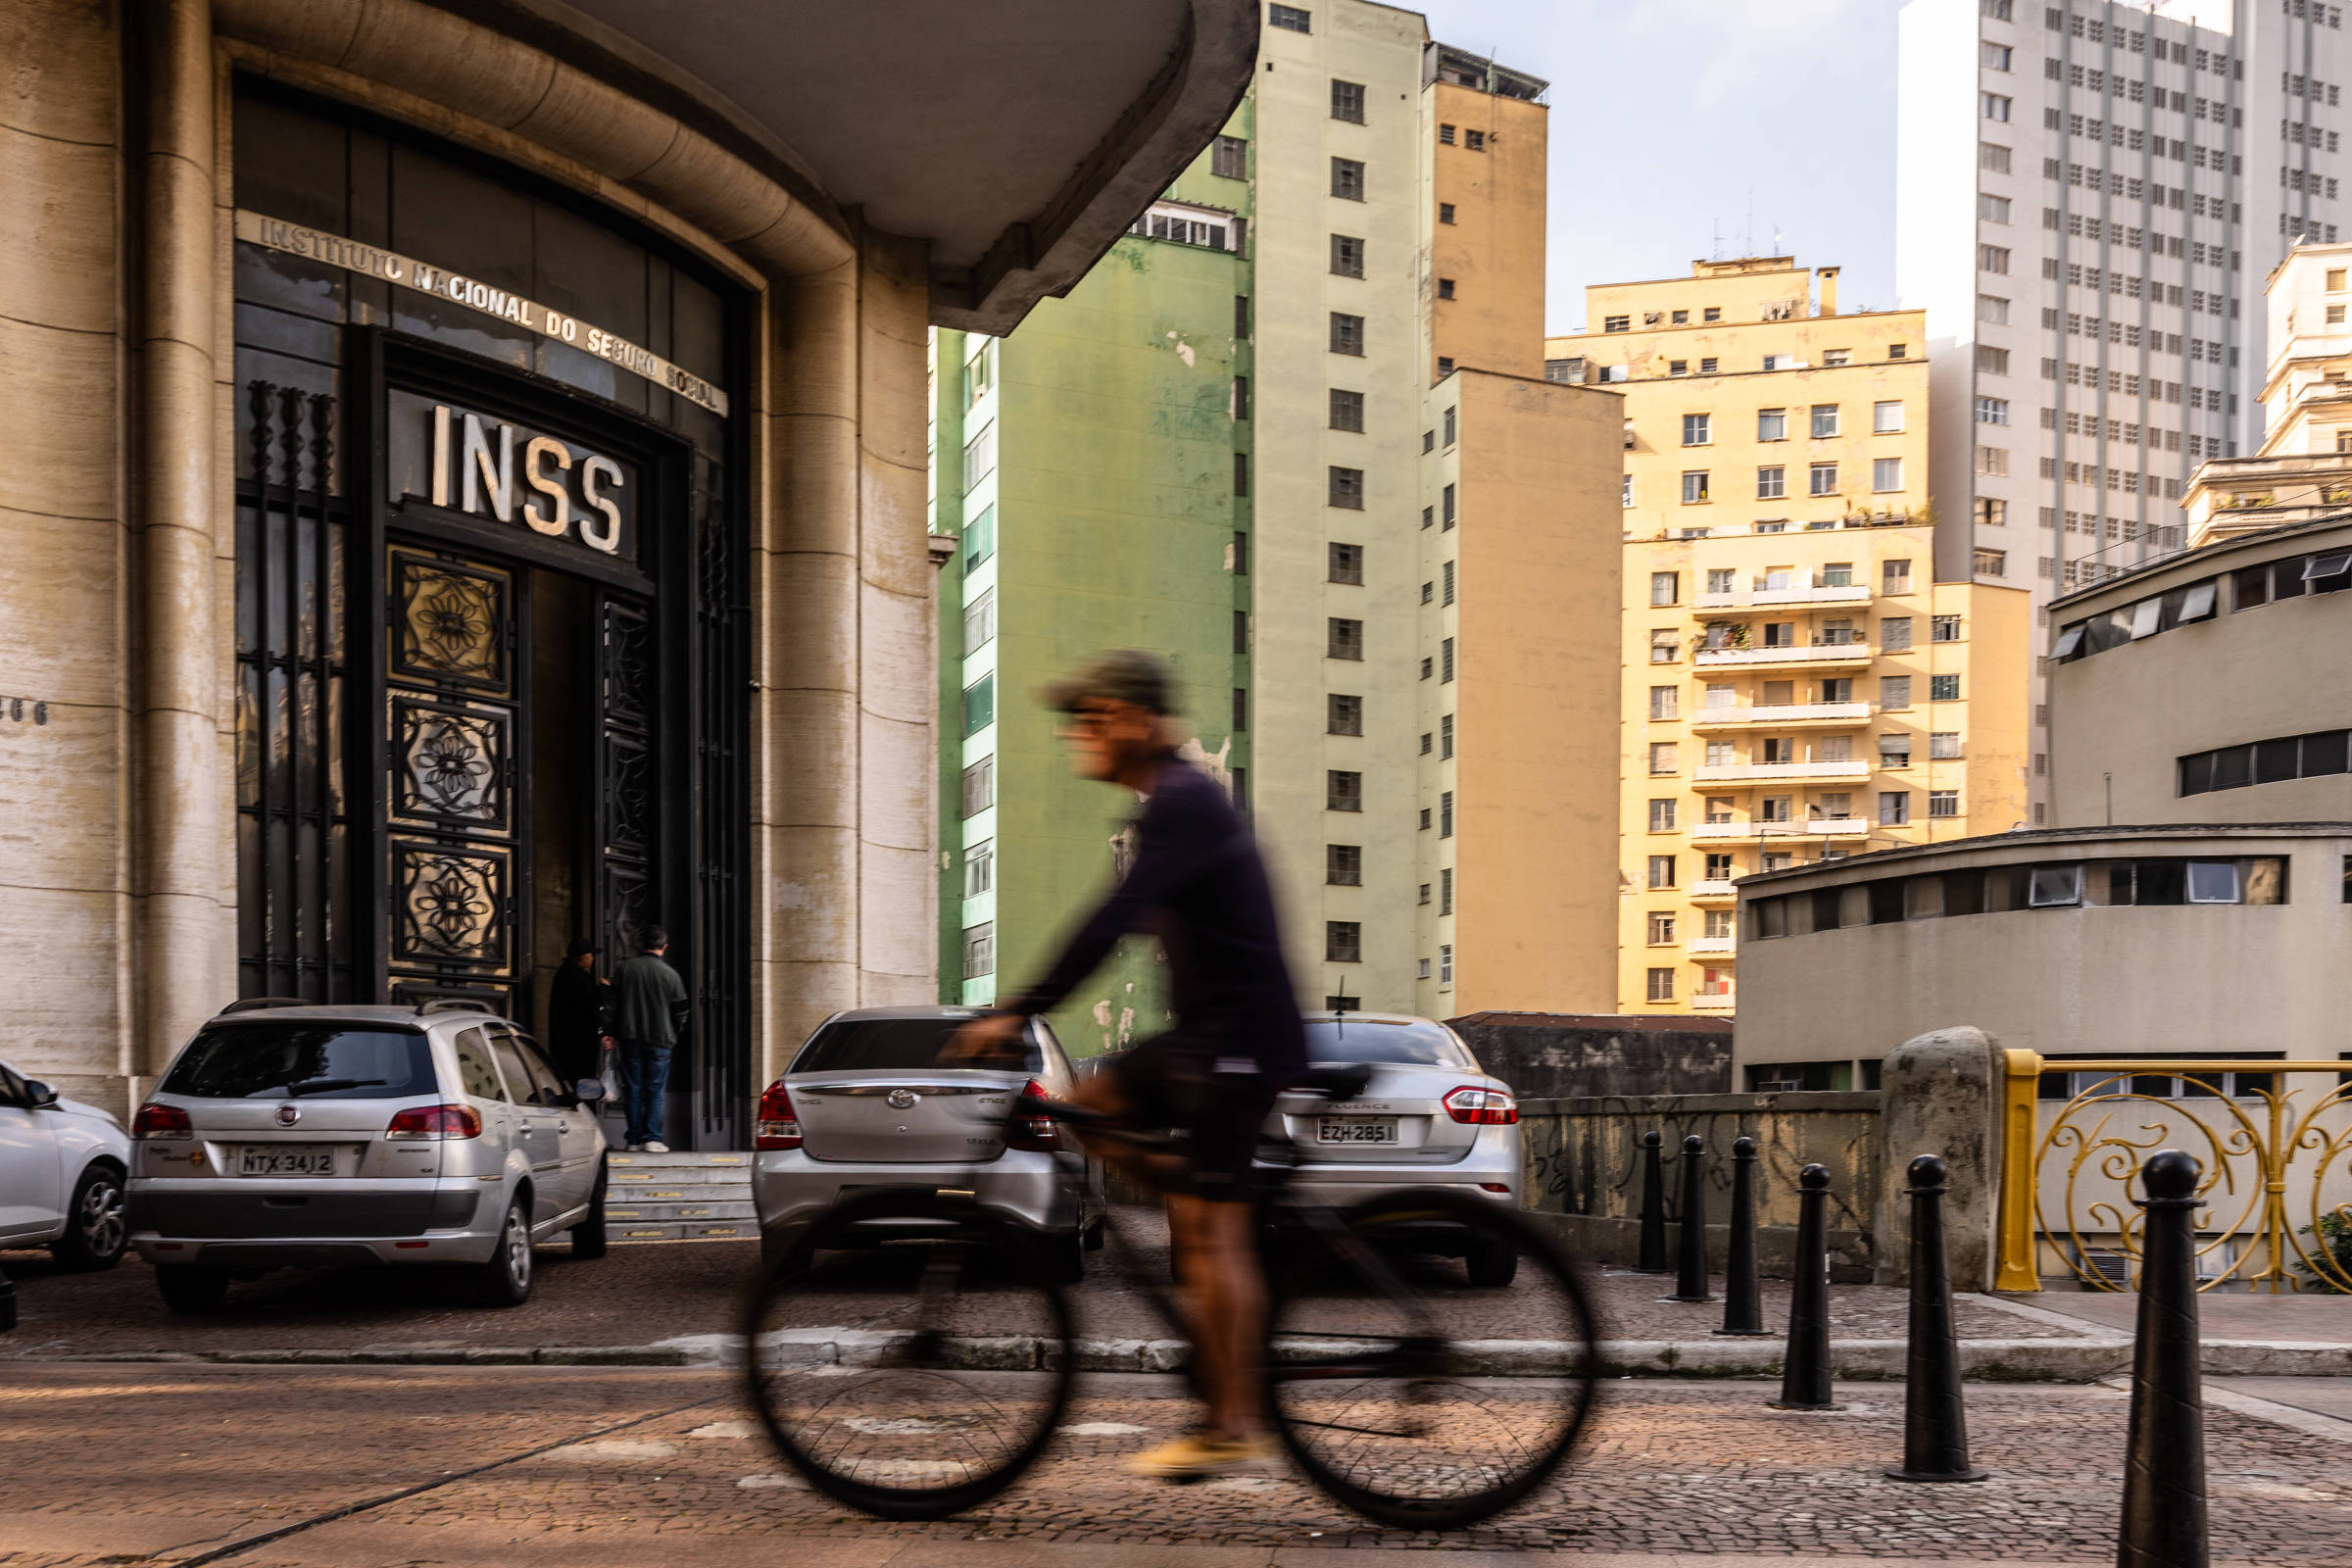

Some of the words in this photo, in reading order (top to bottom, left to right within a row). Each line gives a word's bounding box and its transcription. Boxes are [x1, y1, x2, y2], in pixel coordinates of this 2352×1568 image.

[261, 218, 404, 280] INSTITUTO
[413, 263, 533, 326] NACIONAL
[546, 311, 576, 342] DO
[587, 328, 658, 376] SEGURO
[666, 365, 717, 409] SOCIAL
[432, 405, 624, 556] INSS
[243, 1154, 331, 1172] NTX-3412
[1322, 1126, 1393, 1141] EZH-2851
